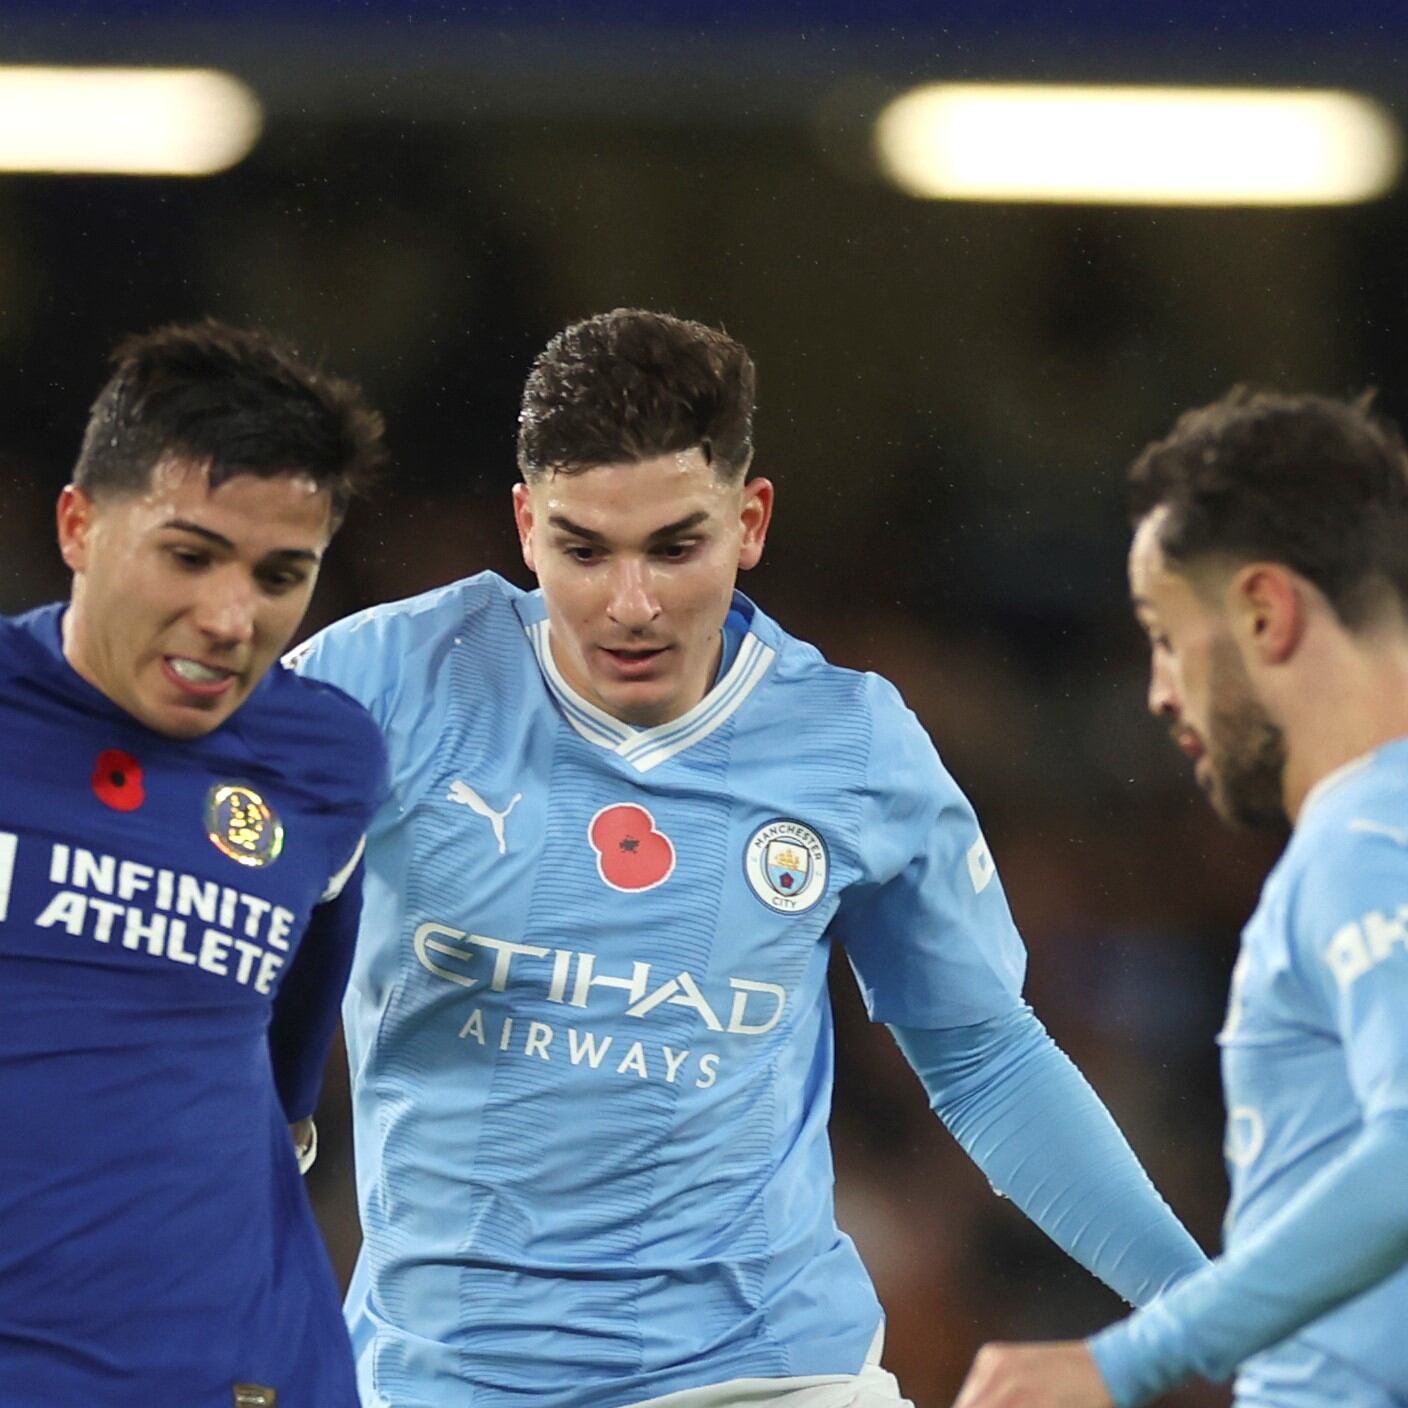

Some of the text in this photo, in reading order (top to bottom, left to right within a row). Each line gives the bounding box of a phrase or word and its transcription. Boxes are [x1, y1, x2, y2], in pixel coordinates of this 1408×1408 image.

[754, 824, 823, 861] MANCHESTER
[34, 890, 284, 995] ATHLETE
[49, 843, 294, 951] INFINITE
[772, 896, 797, 908] CITY
[413, 922, 786, 1034] ETIHAD
[459, 1008, 721, 1089] AIRWAYS
